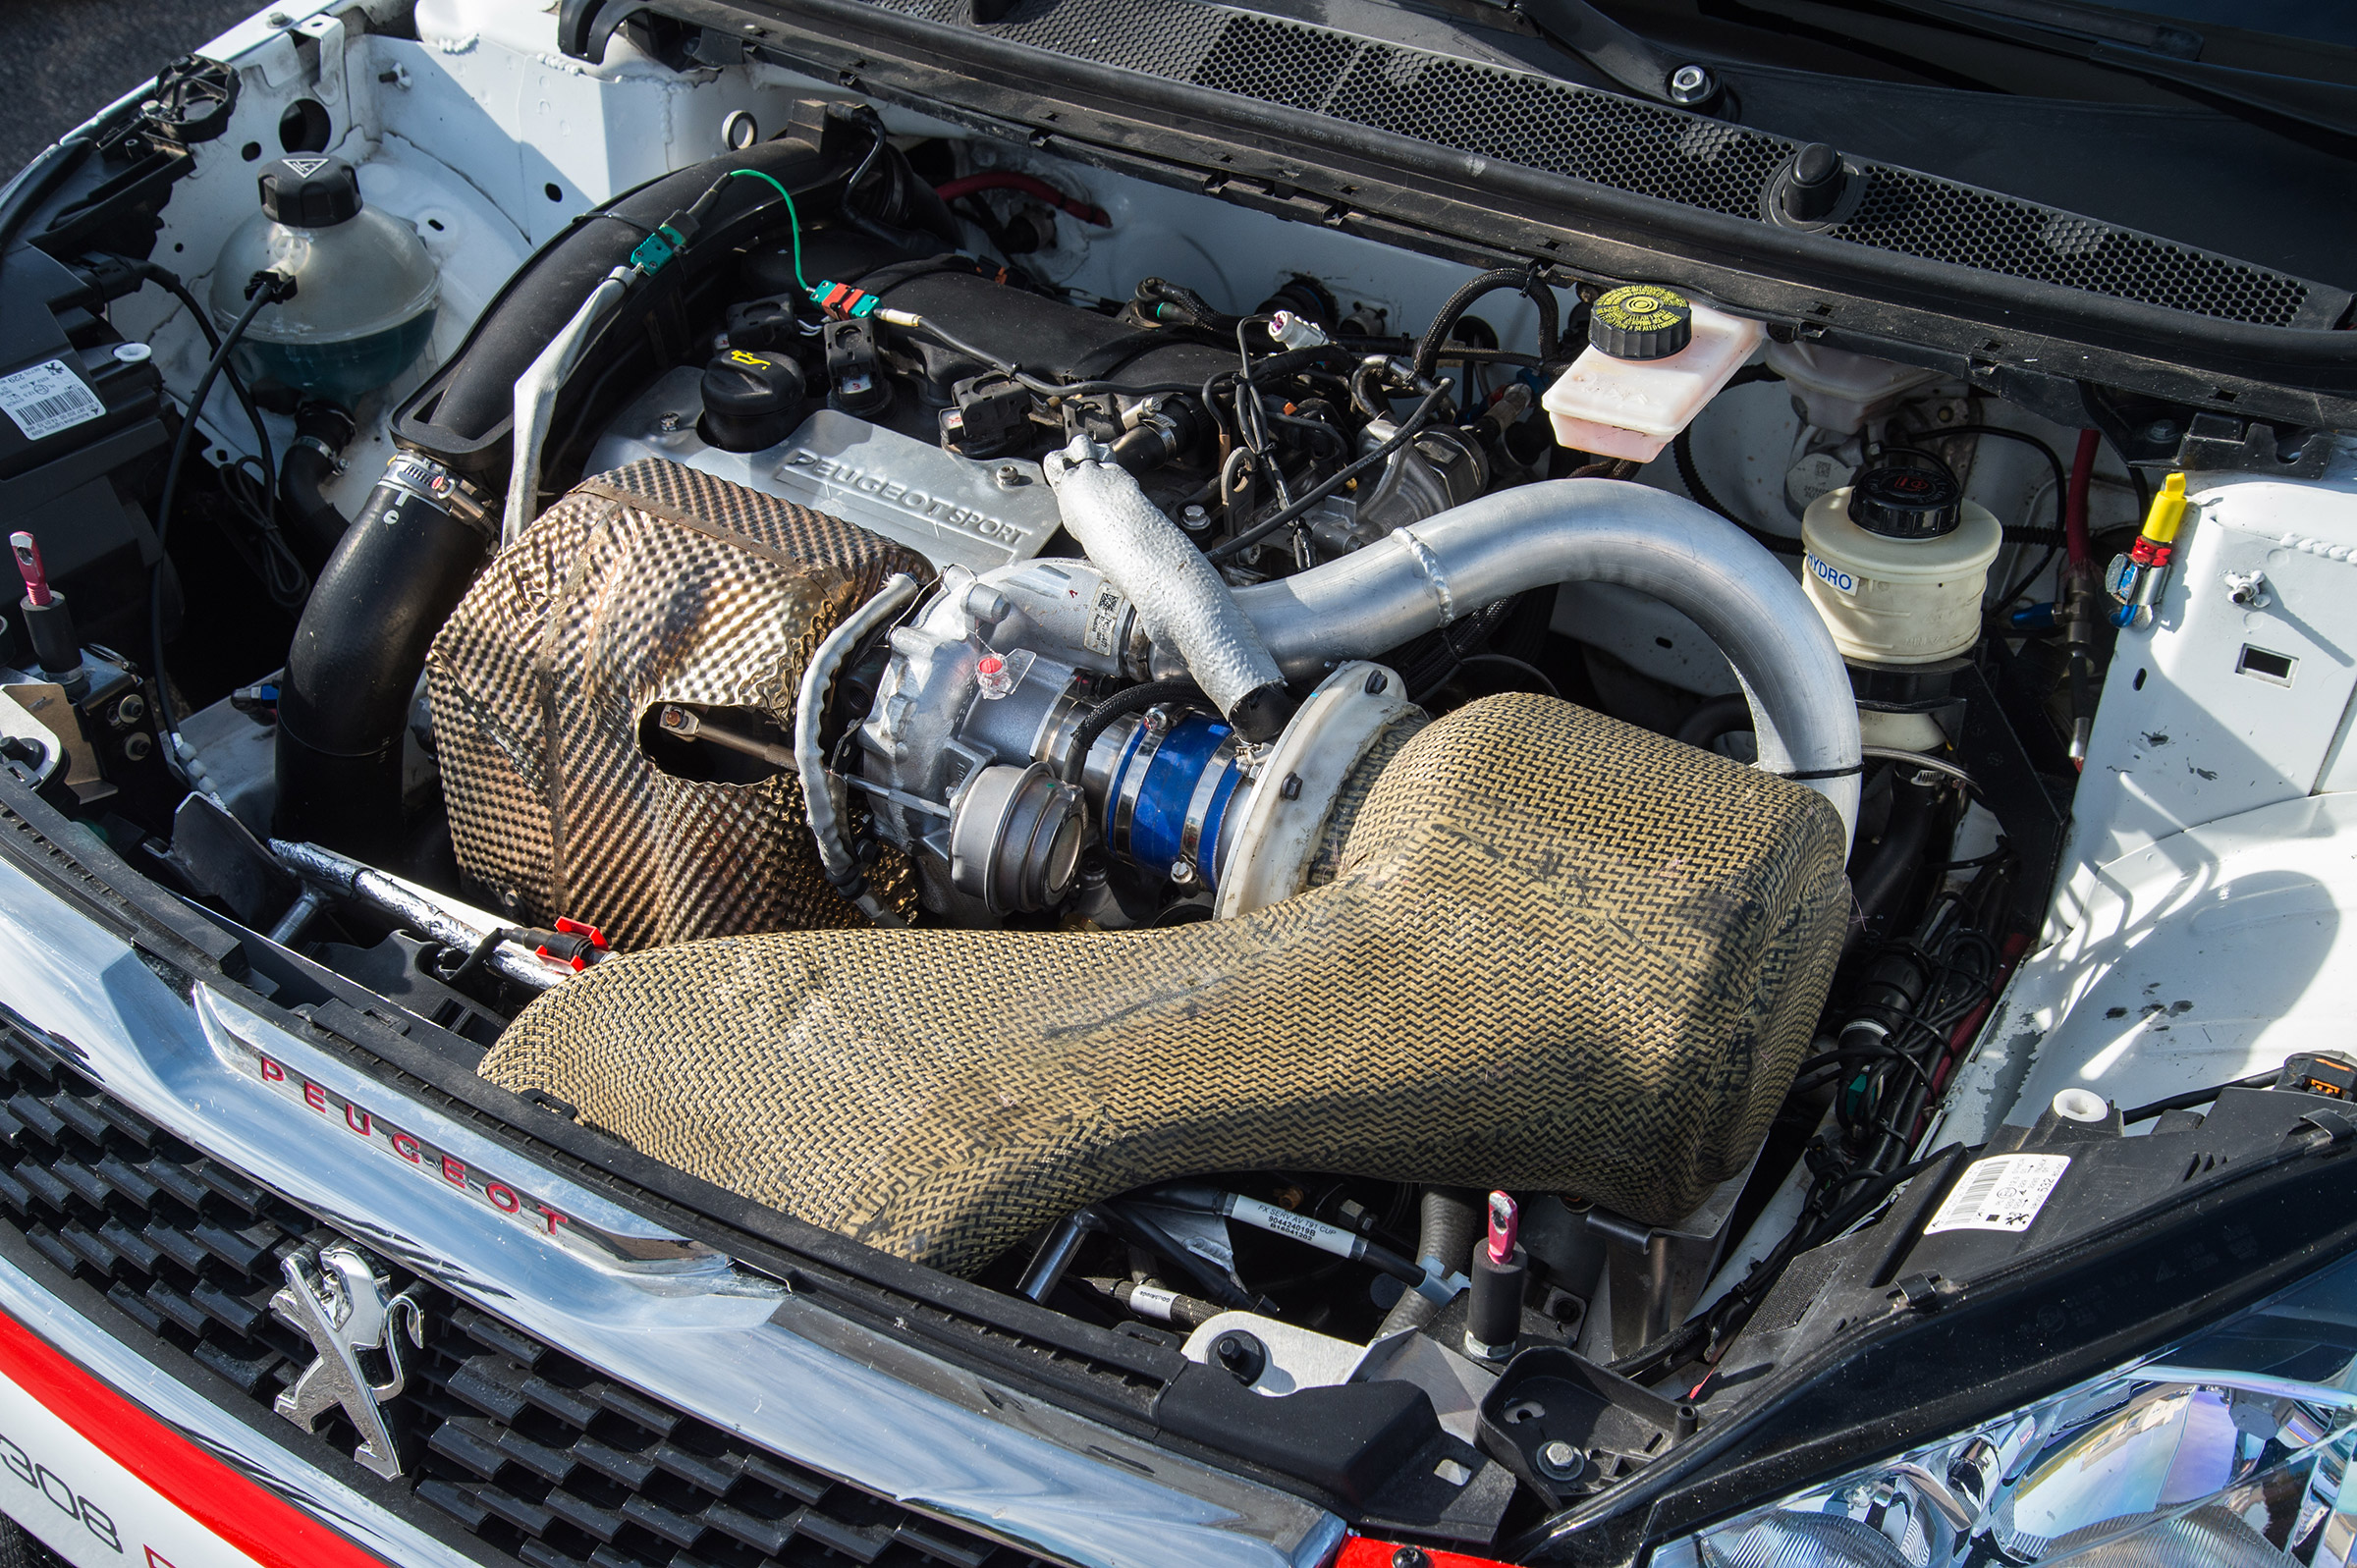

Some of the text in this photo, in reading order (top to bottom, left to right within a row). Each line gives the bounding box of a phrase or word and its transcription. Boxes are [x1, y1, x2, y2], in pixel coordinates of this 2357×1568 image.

[785, 447, 1032, 547] PEUGEOT SPORT
[1807, 550, 1853, 590] HYDRO
[259, 1054, 570, 1237] PEUGEOT
[1257, 1204, 1270, 1213] FX
[1270, 1207, 1291, 1220] SERV
[1291, 1216, 1305, 1225] AV
[1304, 1218, 1318, 1229] T91
[1319, 1225, 1337, 1235] CUP
[1268, 1216, 1316, 1236] 904424019B
[1270, 1223, 1313, 1241] B16041202
[0, 1433, 124, 1554] 308
